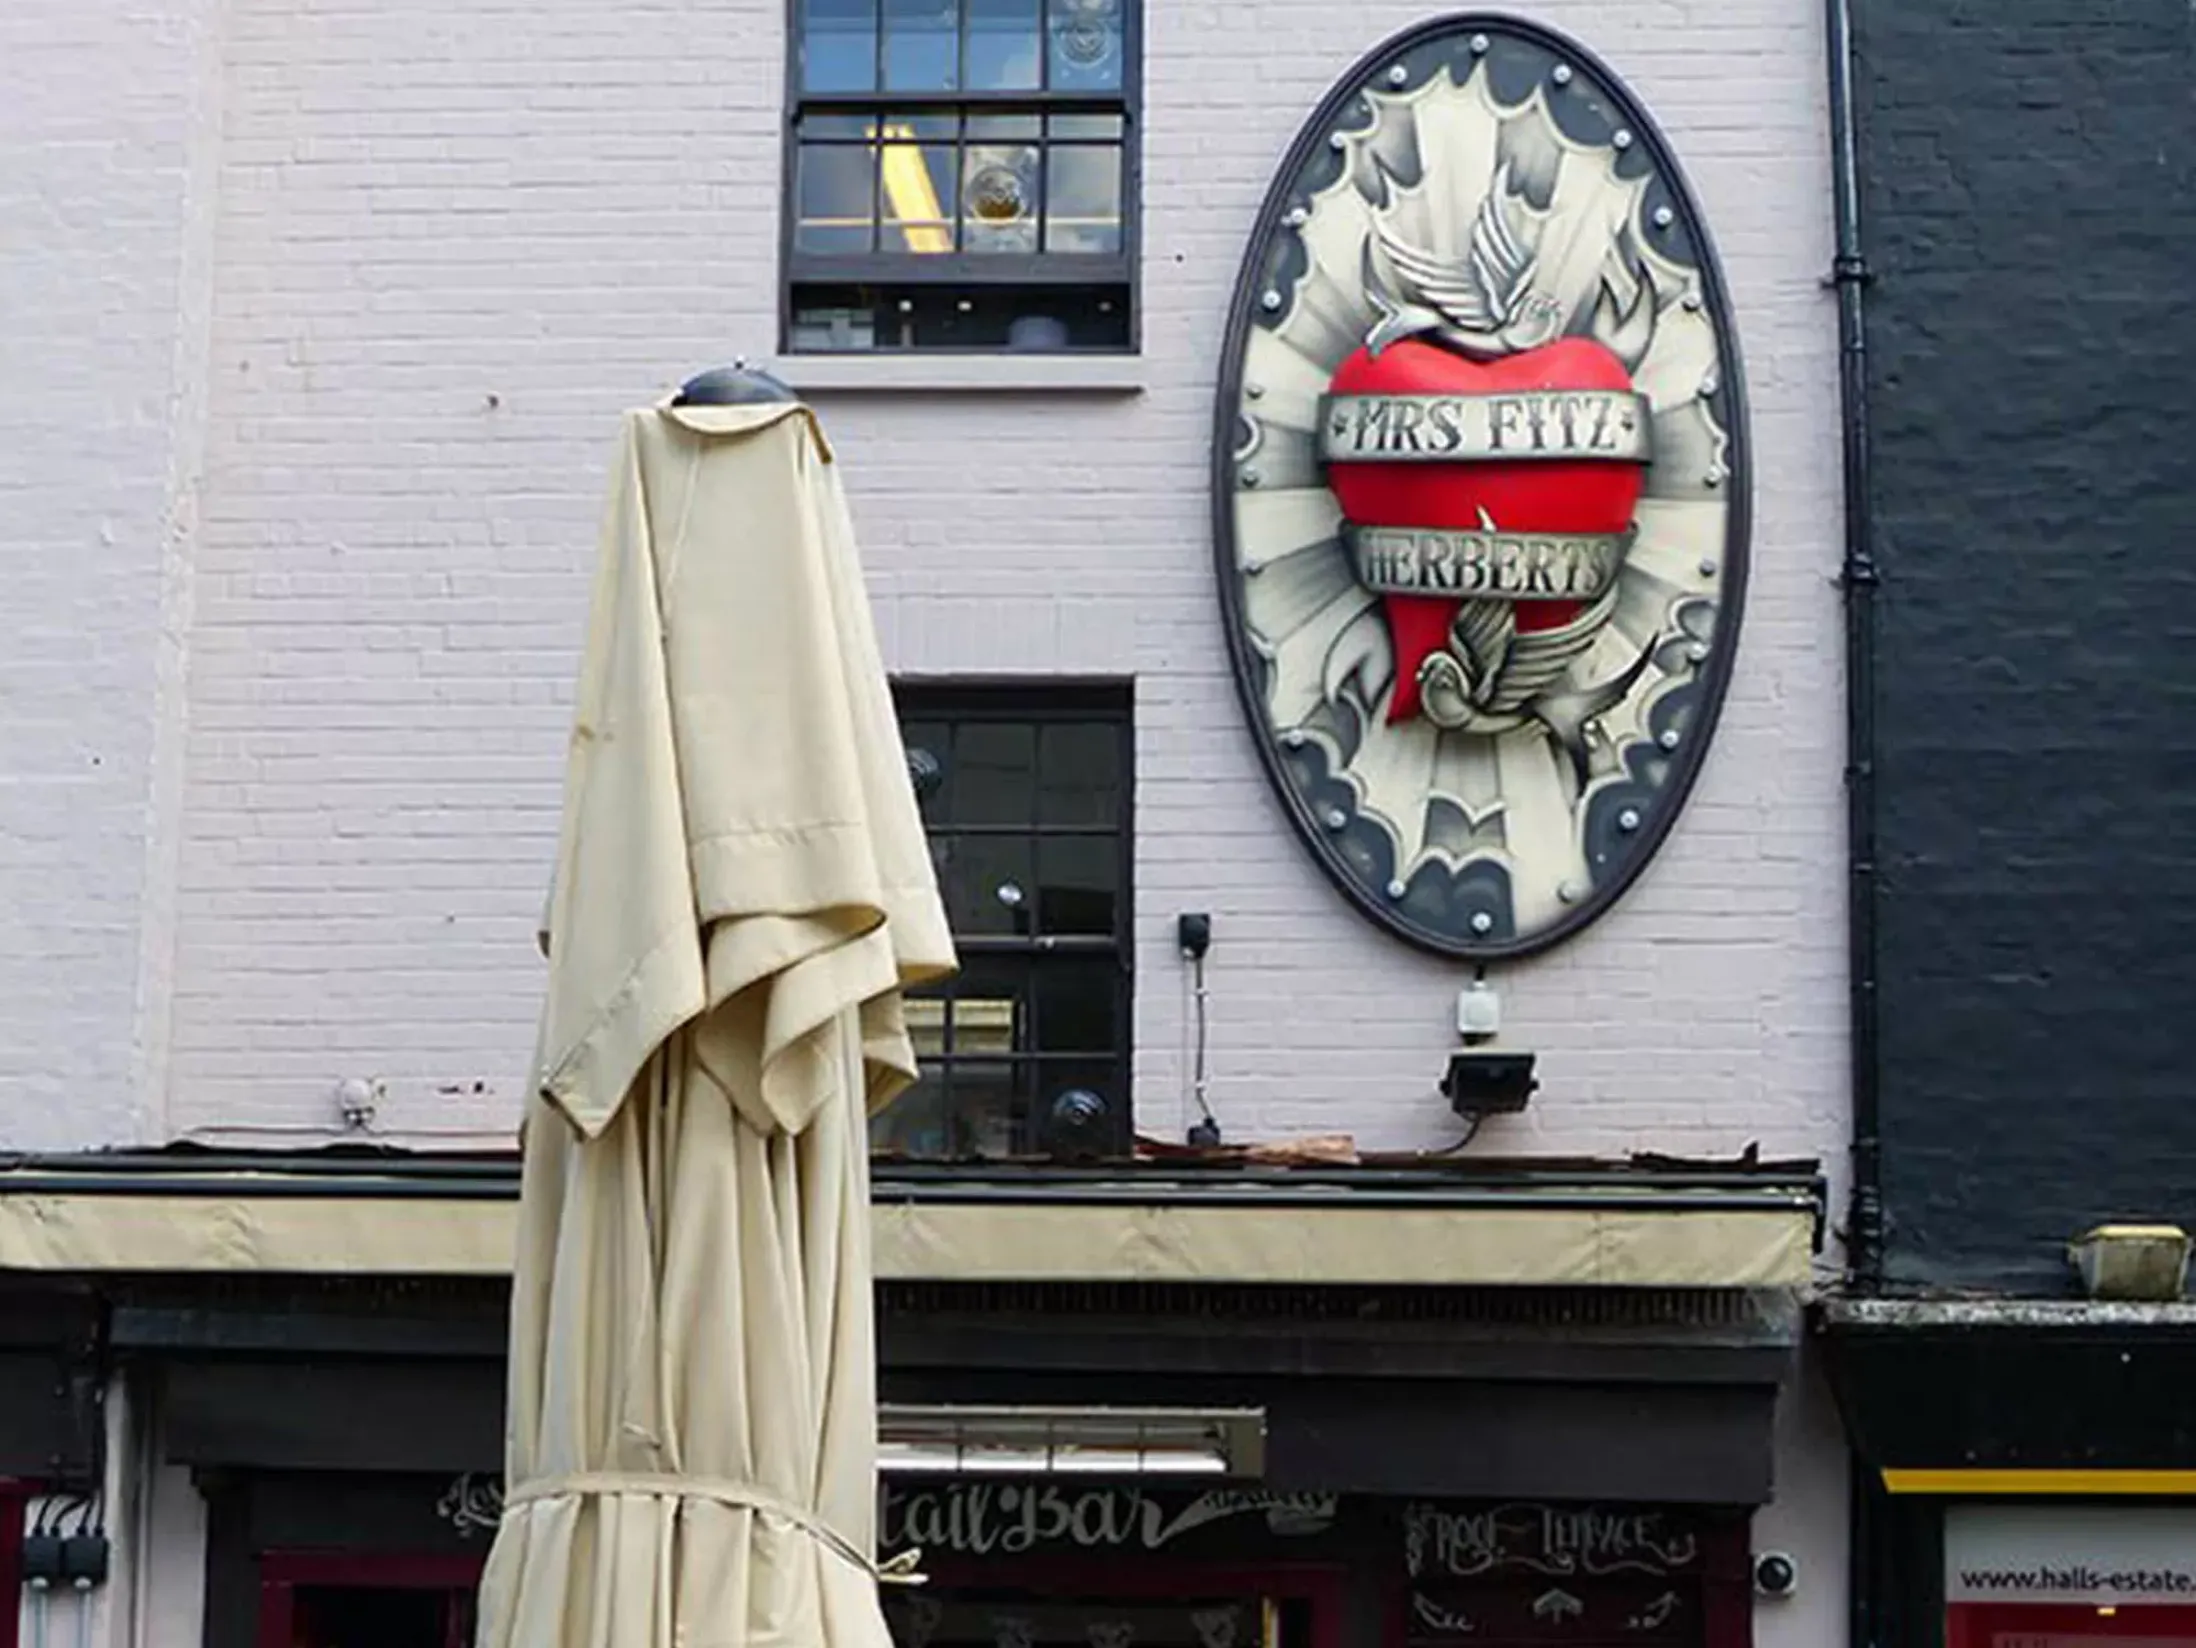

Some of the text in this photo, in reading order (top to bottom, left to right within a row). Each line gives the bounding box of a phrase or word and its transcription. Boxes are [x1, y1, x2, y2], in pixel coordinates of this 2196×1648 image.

[1353, 397, 1617, 451] MRS FITZ
[1359, 529, 1609, 593] HERBERTS
[998, 1483, 1166, 1554] Bar
